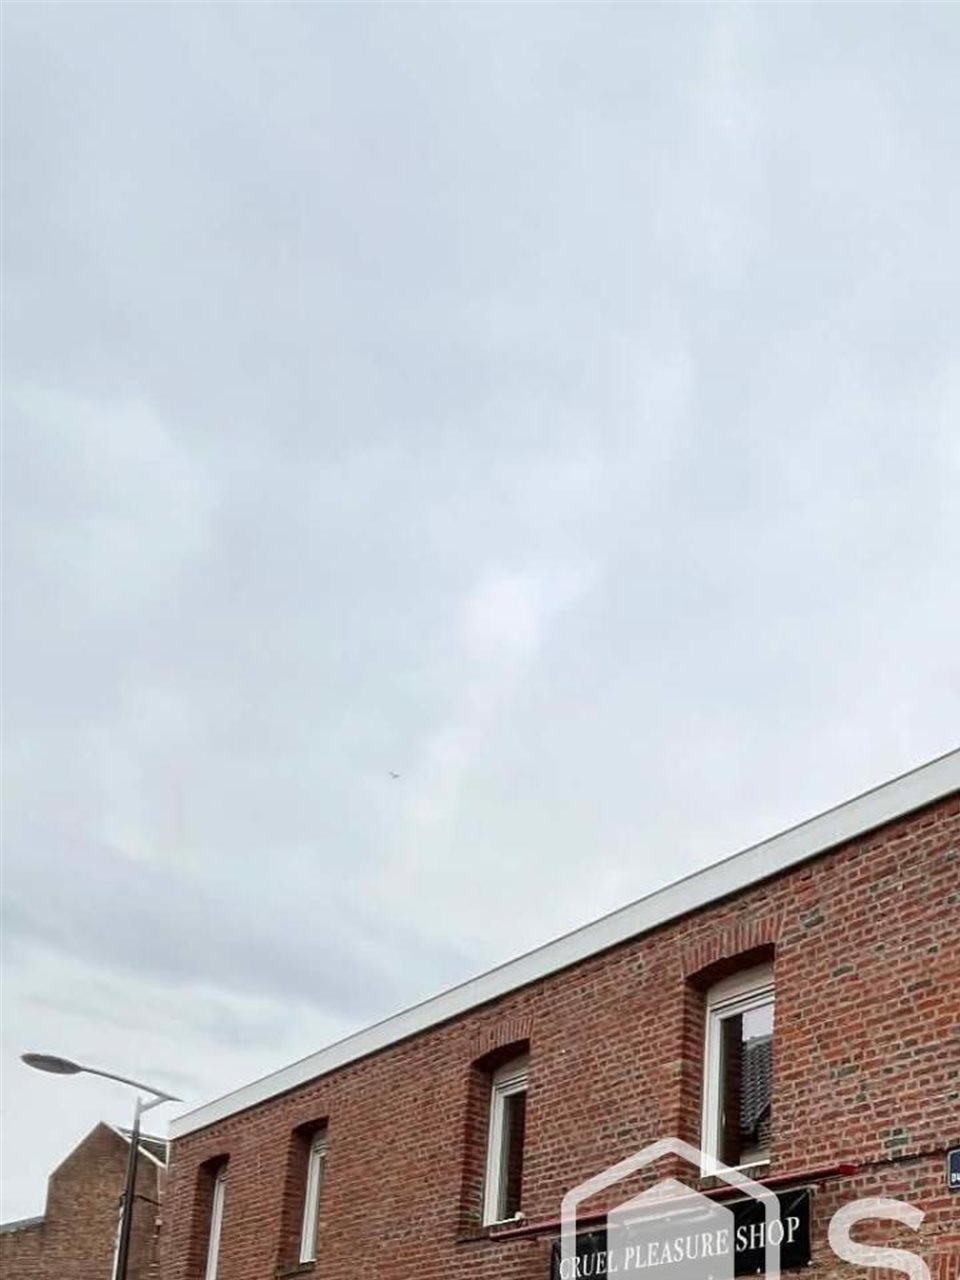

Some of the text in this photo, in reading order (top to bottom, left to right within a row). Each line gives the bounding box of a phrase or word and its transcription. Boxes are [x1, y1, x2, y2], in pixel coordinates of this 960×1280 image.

[559, 1216, 801, 1280] CRUEL PLEASURE SHOP
